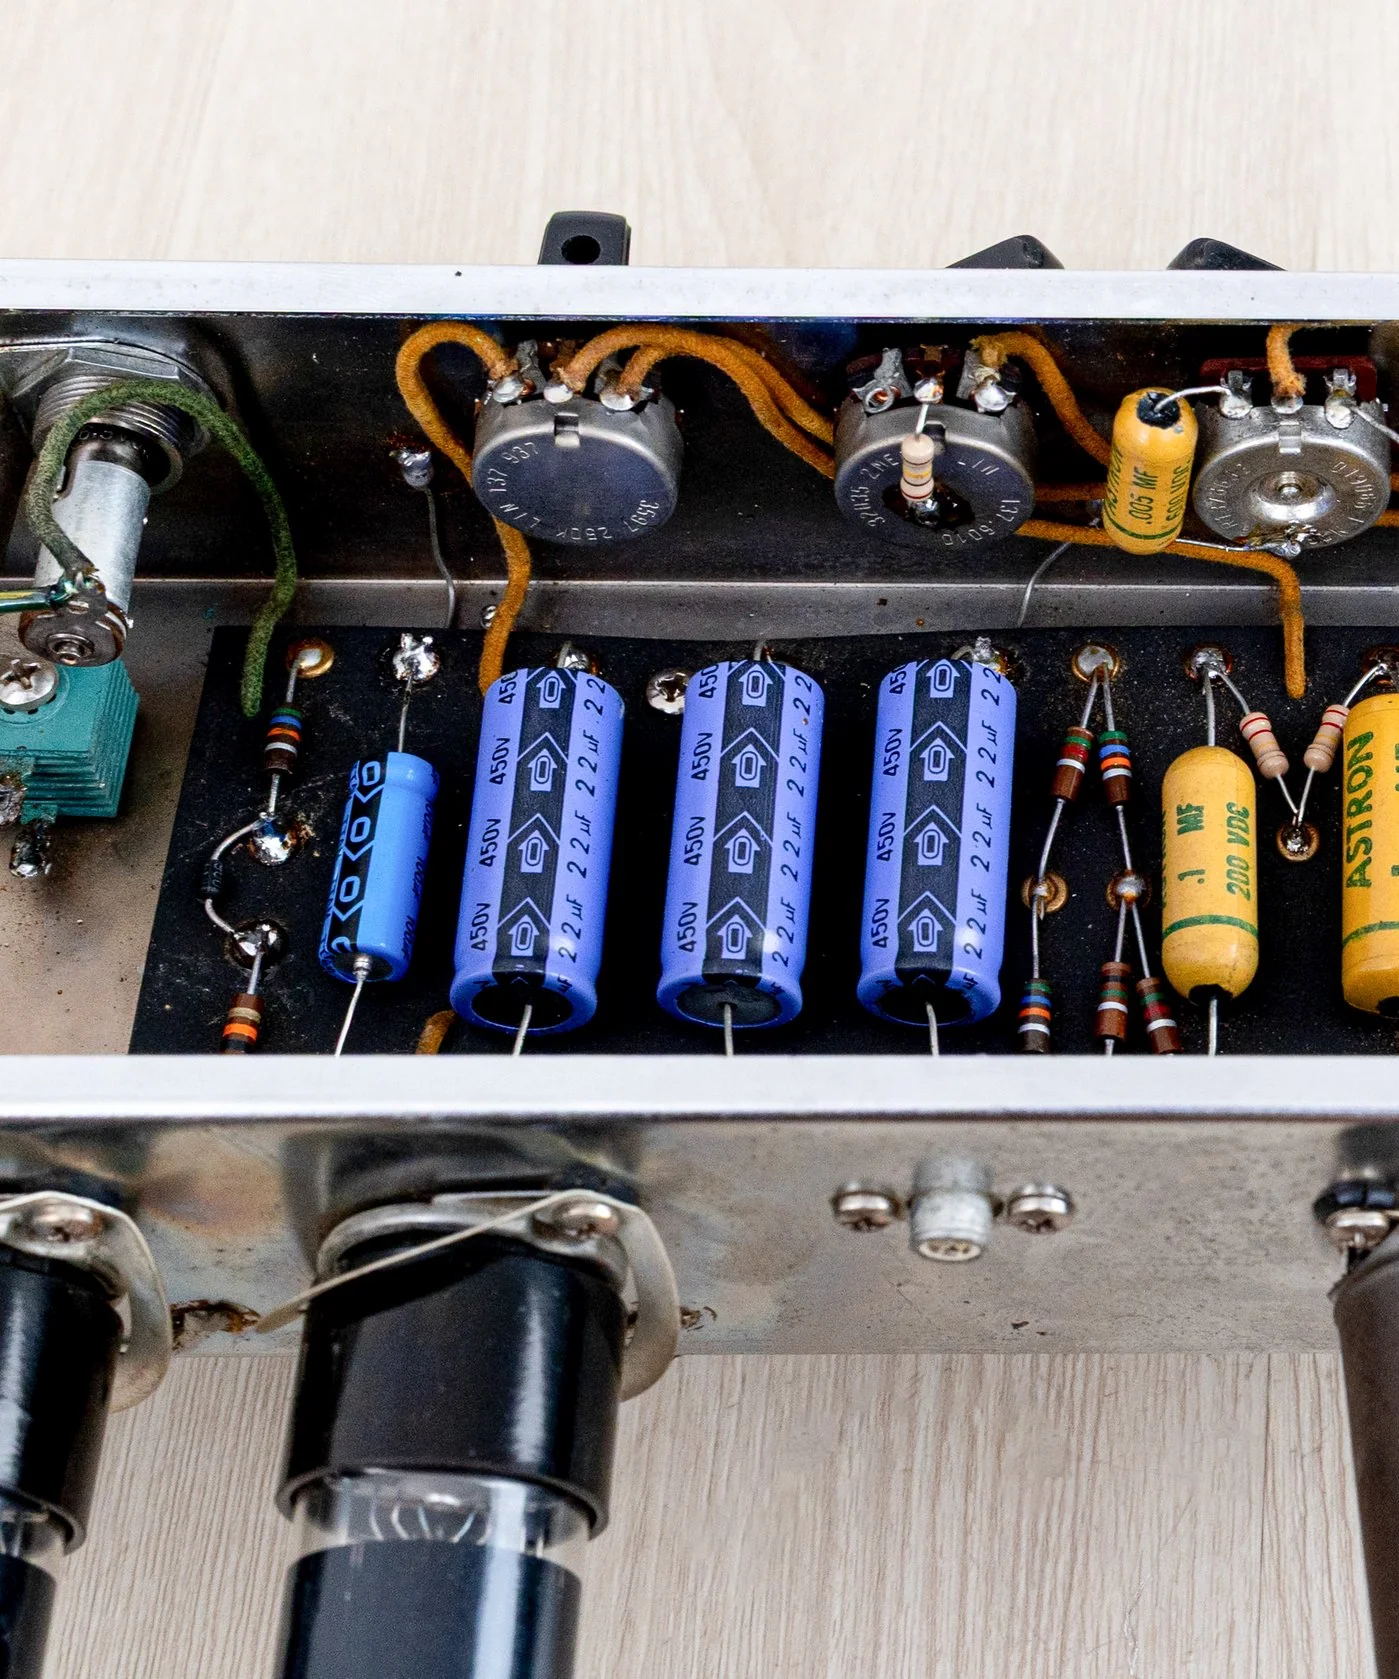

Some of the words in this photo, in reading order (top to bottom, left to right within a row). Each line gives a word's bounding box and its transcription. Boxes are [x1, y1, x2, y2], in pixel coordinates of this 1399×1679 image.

[489, 737, 511, 785] 450V
[691, 732, 713, 781] 450V
[882, 728, 903, 777] 450V
[1176, 802, 1204, 836] MF
[1226, 801, 1250, 848] VDC
[1346, 731, 1374, 889] ASTRON
[479, 818, 502, 867] 450V
[683, 816, 706, 866] 450V
[876, 812, 897, 862] 450V
[1177, 868, 1206, 885] .1
[1226, 854, 1251, 902] 200
[470, 902, 491, 952] 450V
[677, 901, 698, 953] 450V
[870, 898, 890, 949] 450V
